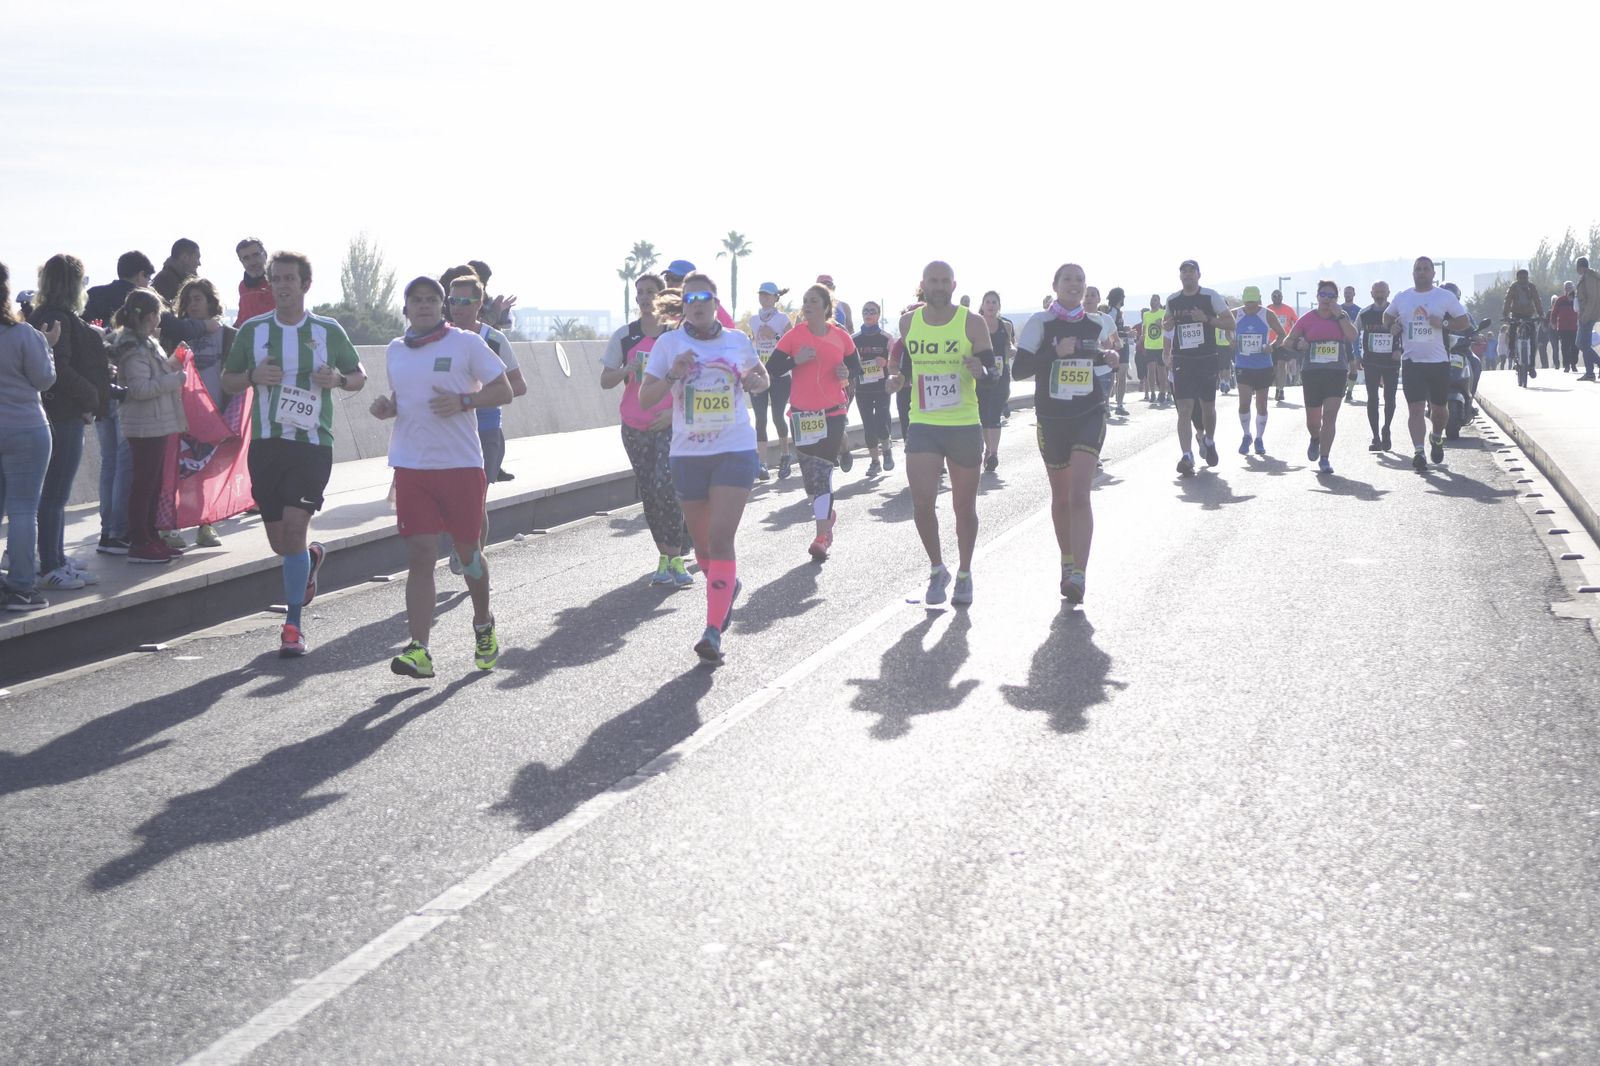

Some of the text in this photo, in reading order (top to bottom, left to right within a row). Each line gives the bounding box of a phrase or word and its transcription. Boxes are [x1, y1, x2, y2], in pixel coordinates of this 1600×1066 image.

[1182, 329, 1201, 338] 6839
[909, 340, 939, 354] Dia
[1317, 346, 1336, 354] 7695
[863, 366, 880, 374] 7692
[1060, 370, 1090, 382] 5557
[926, 384, 957, 397] 1734
[280, 397, 314, 416] 7799
[695, 397, 730, 410] 7026
[801, 419, 824, 431] 8236
